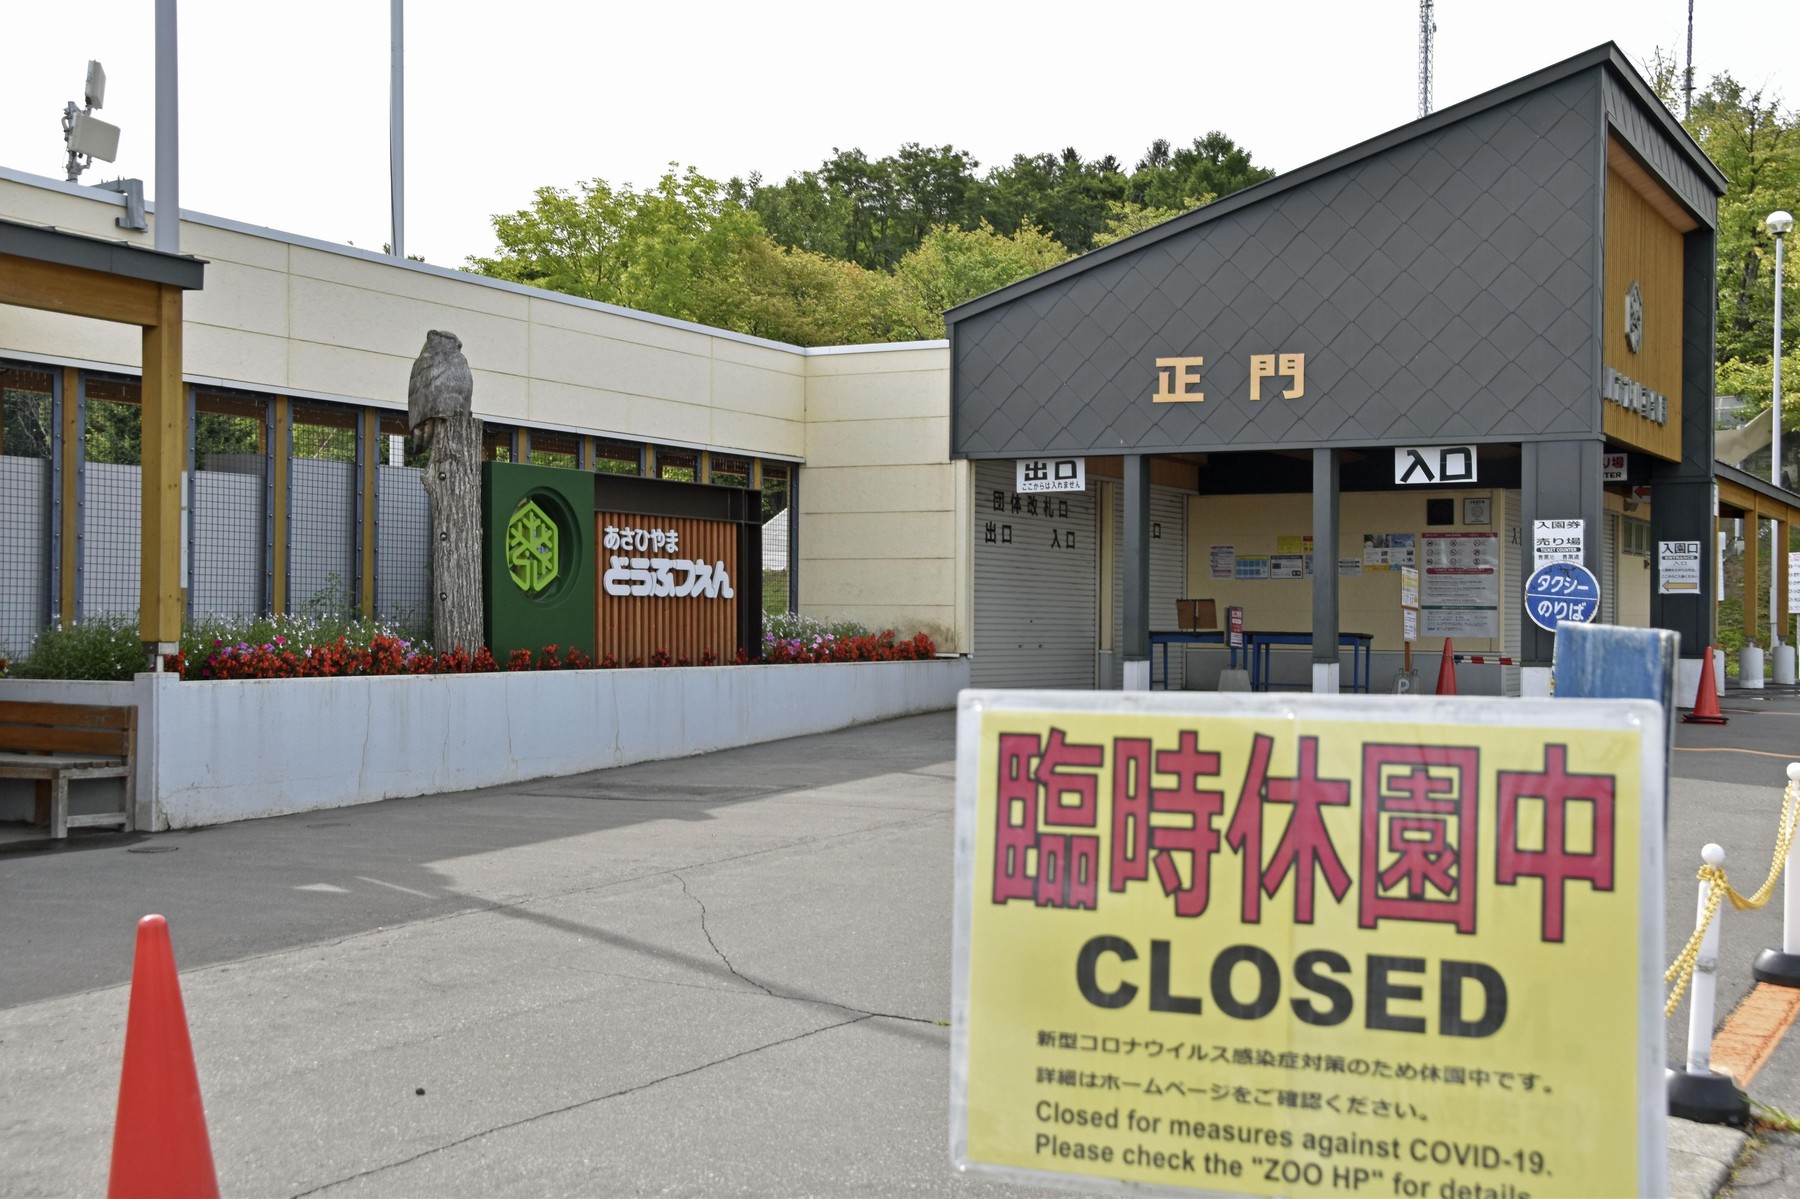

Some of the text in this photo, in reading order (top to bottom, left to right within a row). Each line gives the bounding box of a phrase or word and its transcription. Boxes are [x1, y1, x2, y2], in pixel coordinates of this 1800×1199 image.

[1153, 353, 1305, 403] 正門
[1024, 460, 1078, 481] 出口
[1400, 447, 1472, 483] 入口
[1603, 471, 1622, 479] TER
[1022, 481, 1081, 491] ここからは入れません
[993, 490, 1068, 518] 団体改札口
[604, 525, 679, 553] あさひやま
[985, 521, 1075, 549] 出口 入口
[1536, 521, 1581, 529] 入園券
[1536, 537, 1581, 546] 売り場
[1662, 543, 1698, 554] 入園口
[603, 555, 734, 599] どうぶつえん
[1537, 575, 1589, 594] タクシー
[1537, 600, 1586, 621] のりば
[991, 727, 1616, 943] 臨時休園中
[1076, 935, 1508, 1039] CLOSED
[1036, 1029, 1553, 1094] 新型コロナウイルス感染症対策のため休園中です。
[1036, 1066, 1429, 1122] 詳細はホームページをご確認ください。
[1036, 1100, 1553, 1177] Closed for measures against COVID-19.
[1035, 1133, 1114, 1162] Please
[1122, 1144, 1196, 1173] check
[1204, 1152, 1243, 1178] the
[1251, 1155, 1323, 1187] "ZOO
[1332, 1166, 1384, 1192] HP"
[1392, 1171, 1431, 1198] for
